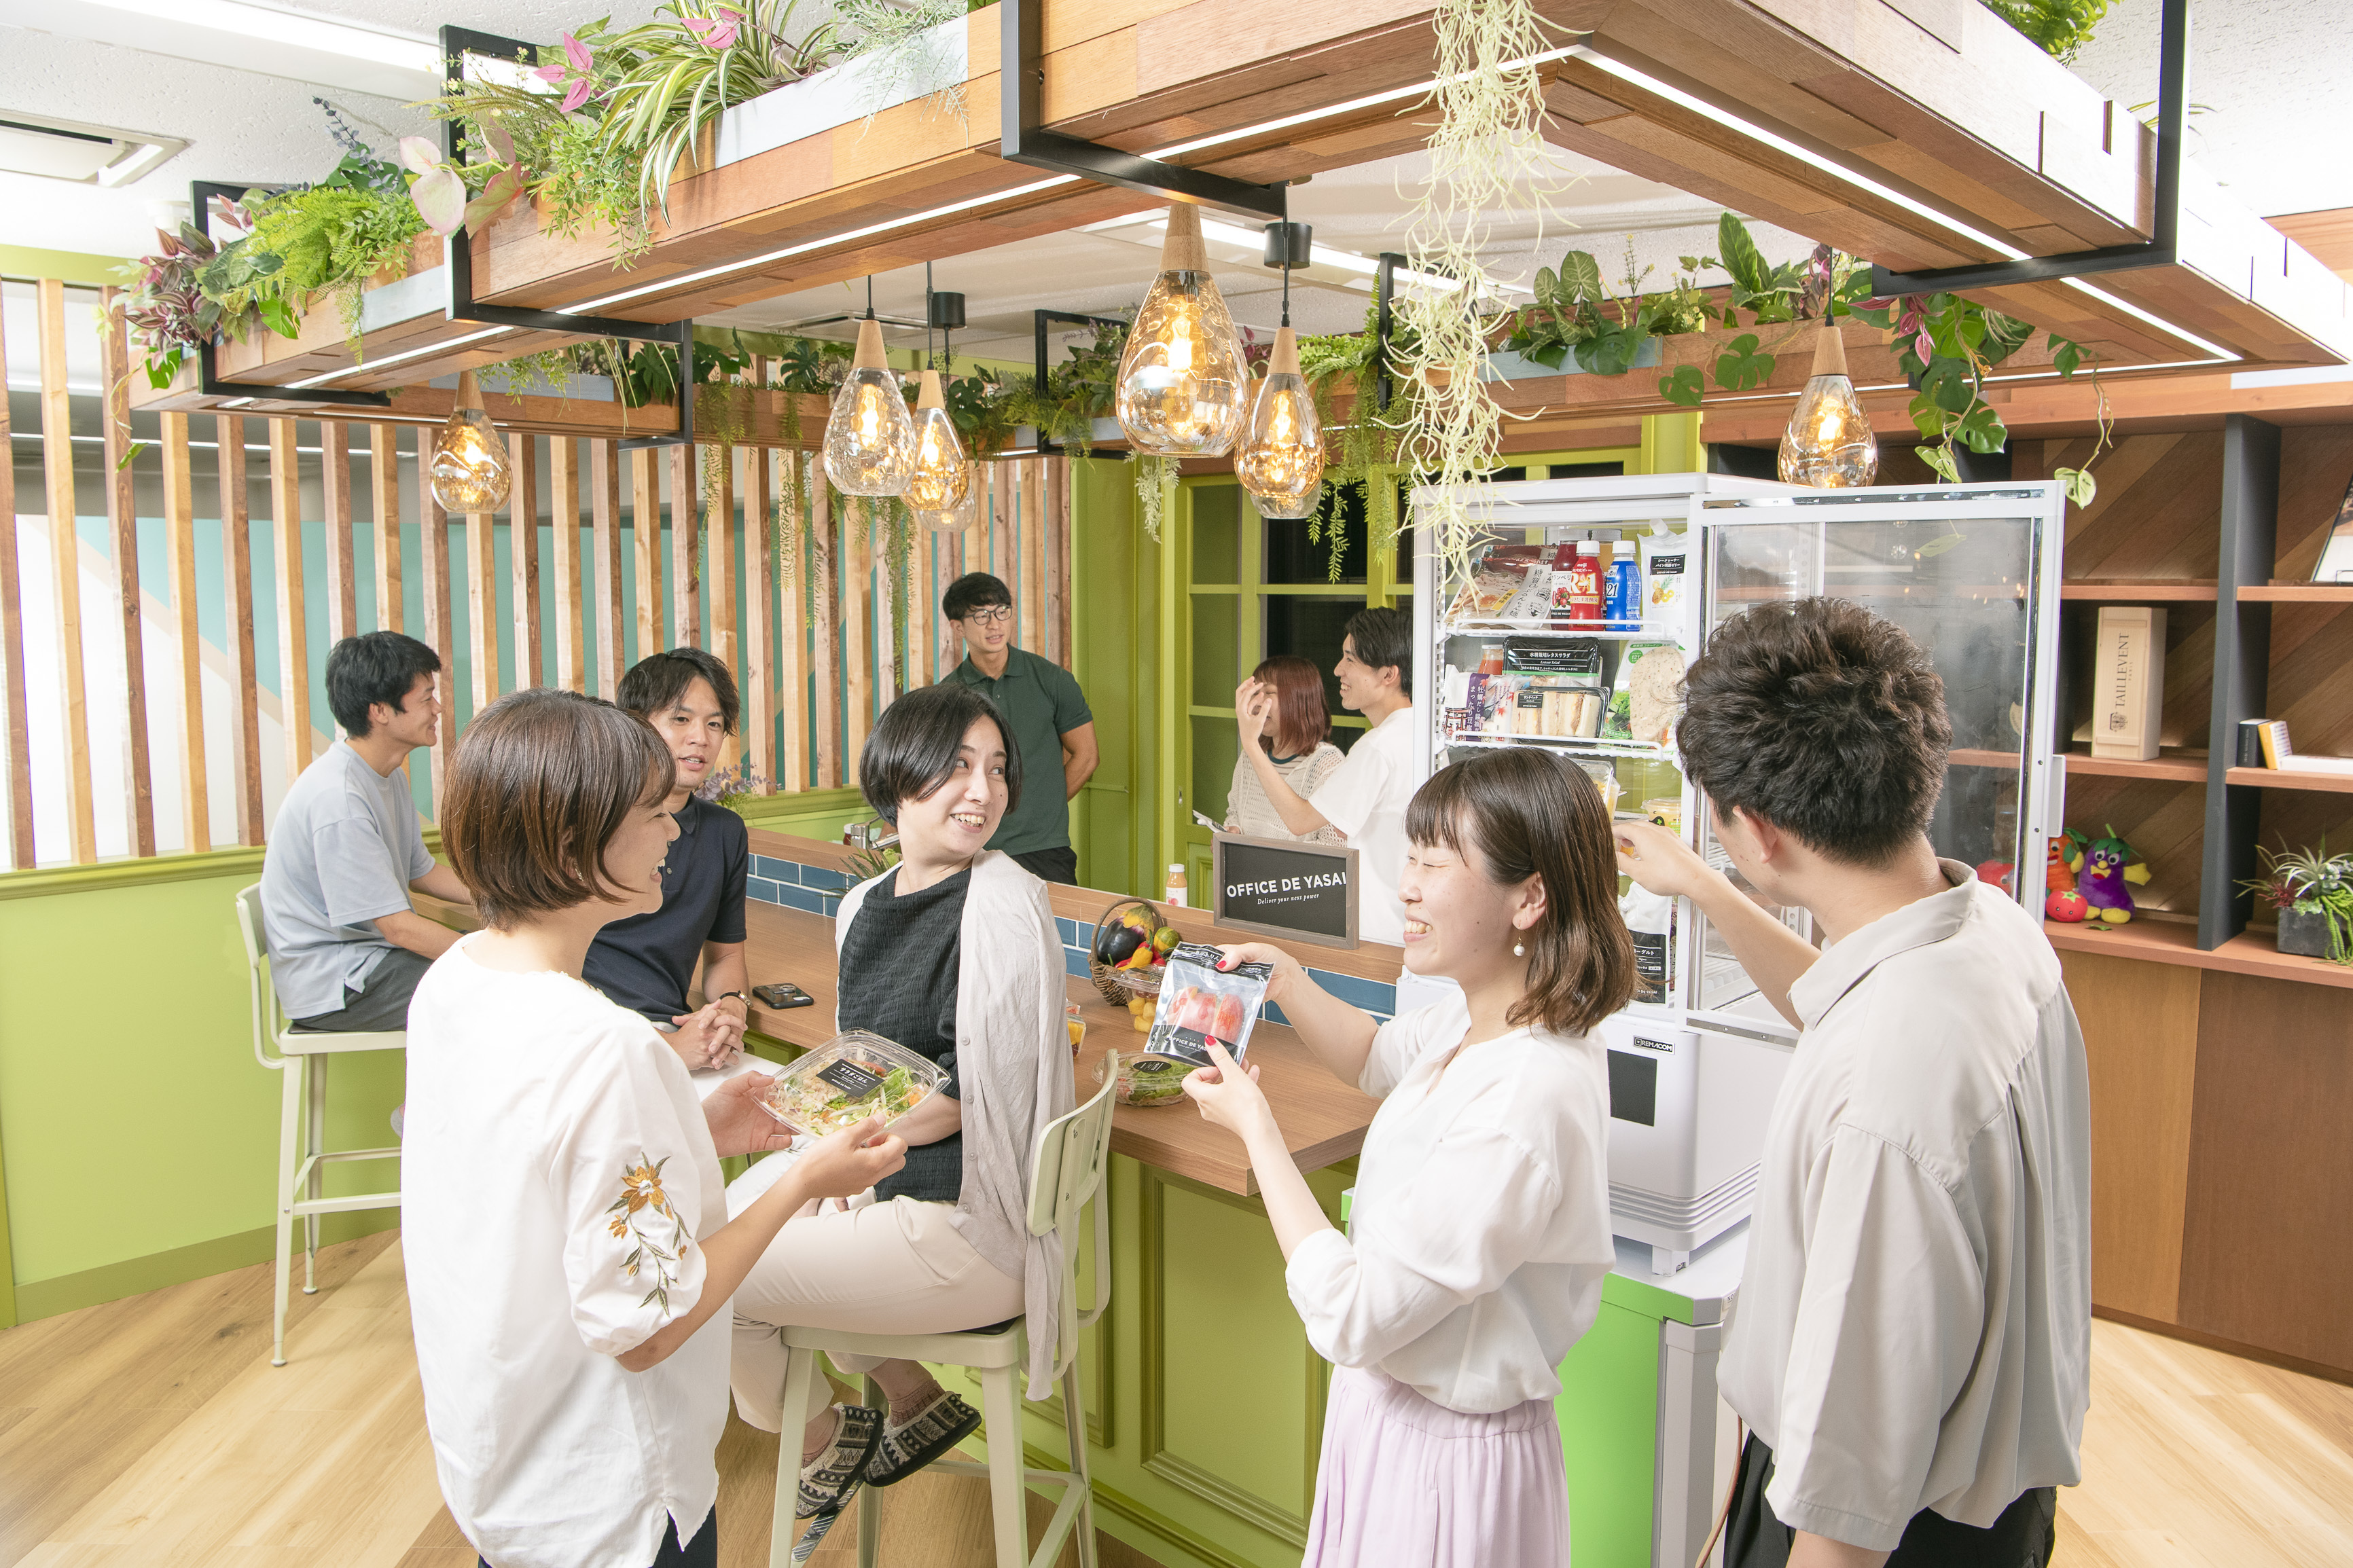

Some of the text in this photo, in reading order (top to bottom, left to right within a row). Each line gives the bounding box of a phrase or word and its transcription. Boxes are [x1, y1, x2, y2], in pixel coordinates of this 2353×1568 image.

[2115, 632, 2130, 709] TAILLEVENT
[1227, 871, 1347, 898] OFFICE DE YASAI
[1277, 896, 1290, 905] your
[1303, 893, 1320, 902] power
[1642, 1040, 1672, 1052] REMACOM
[840, 1067, 868, 1084] サラダごはん
